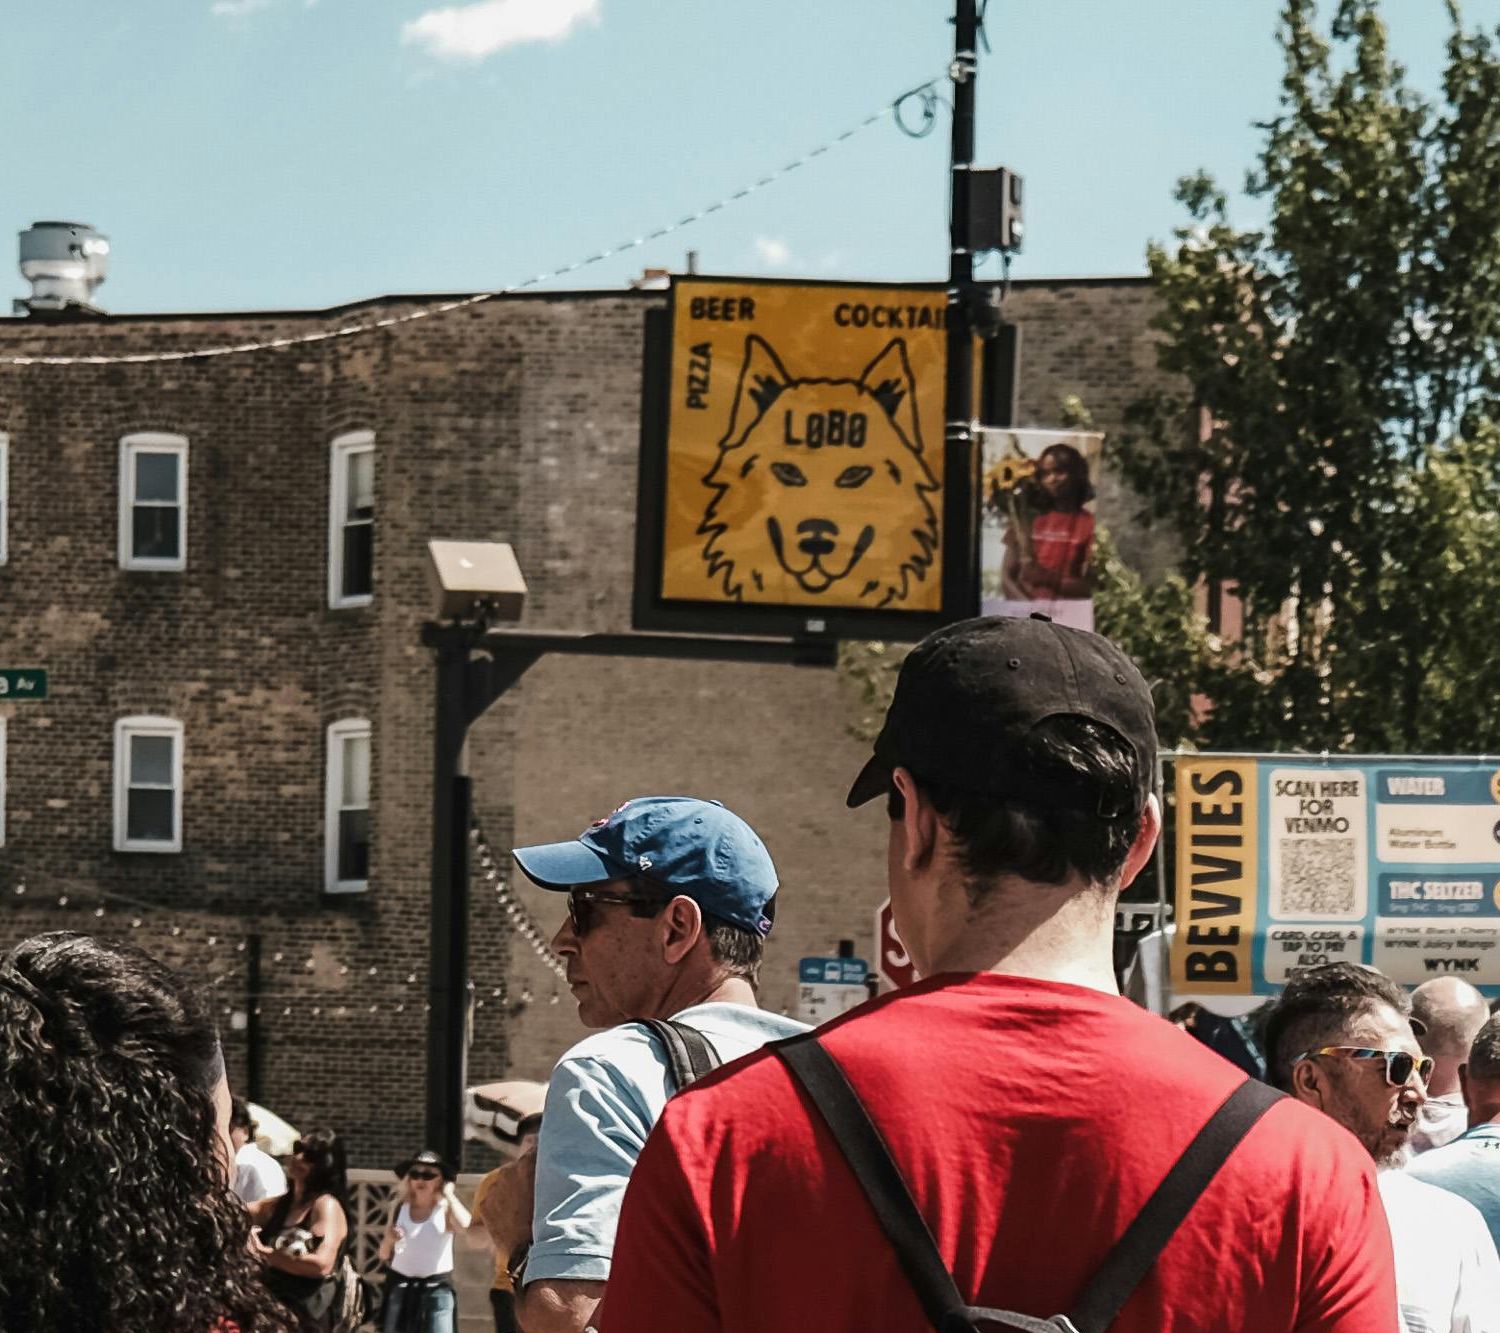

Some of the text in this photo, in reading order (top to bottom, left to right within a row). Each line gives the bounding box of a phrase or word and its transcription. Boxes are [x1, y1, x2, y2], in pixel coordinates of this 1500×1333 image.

[690, 296, 755, 321] BEER
[686, 342, 712, 409] PIZZA
[1276, 780, 1359, 797] SCAN HERE
[1300, 800, 1334, 816] FOR
[1284, 817, 1349, 833] VENMO
[1185, 769, 1243, 982] BEVVIES
[1297, 954, 1329, 965] ALSO
[1424, 958, 1480, 971] WYNK
